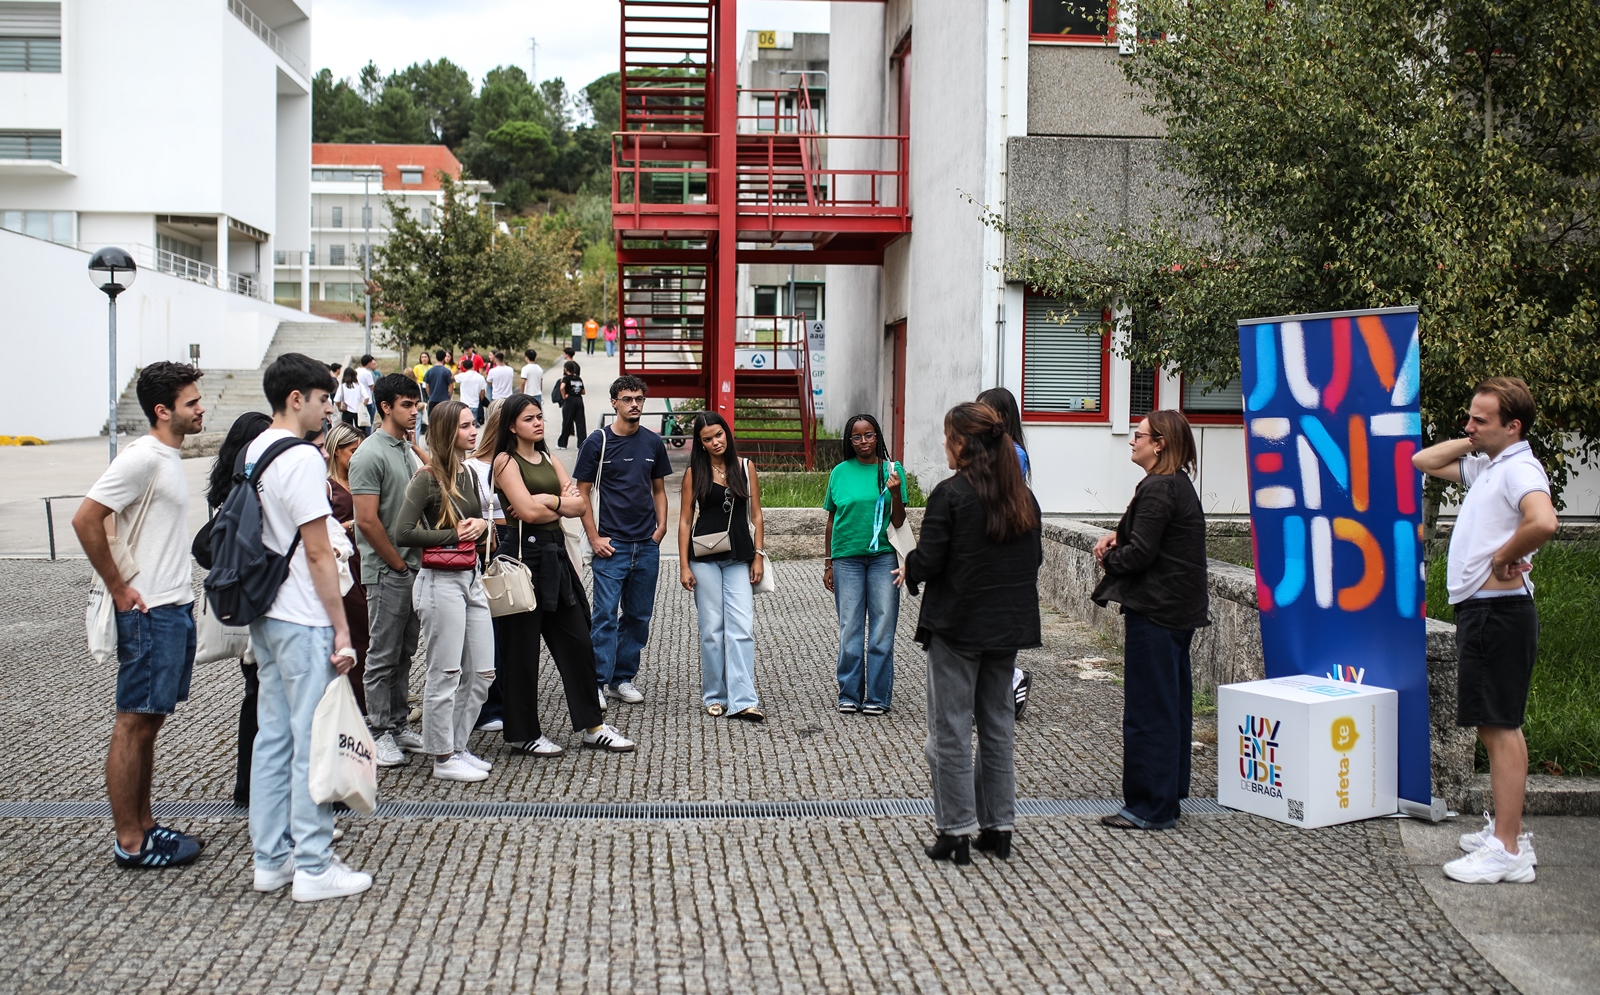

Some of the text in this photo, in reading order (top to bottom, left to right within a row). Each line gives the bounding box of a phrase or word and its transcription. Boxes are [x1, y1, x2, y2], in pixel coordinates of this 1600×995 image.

[759, 32, 775, 45] 06
[1326, 663, 1365, 685] JUV
[1238, 714, 1281, 741] JUV
[1240, 735, 1279, 764] ENT
[1240, 757, 1283, 788] UDE
